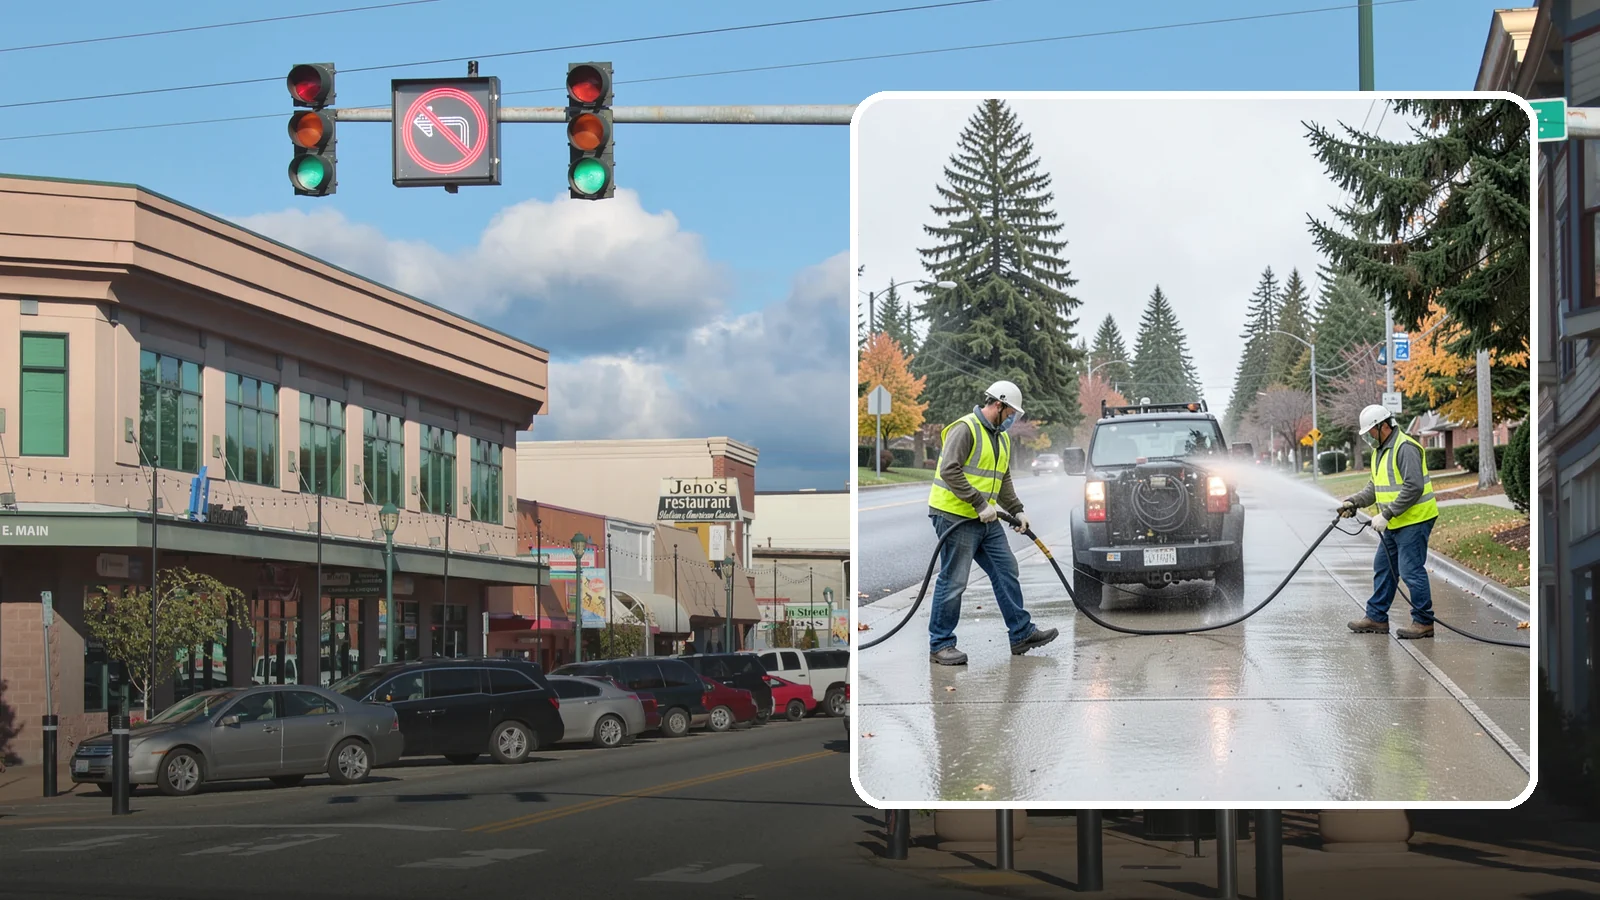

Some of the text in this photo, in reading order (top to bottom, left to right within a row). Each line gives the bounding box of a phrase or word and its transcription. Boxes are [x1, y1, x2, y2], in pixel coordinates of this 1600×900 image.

[669, 480, 727, 494] Jeno's
[665, 496, 730, 509] restaurant
[659, 510, 681, 519] Italian
[686, 510, 714, 519] American
[715, 509, 737, 519] Cuisine
[2, 525, 49, 536] E. MAIN
[798, 608, 828, 617] Street
